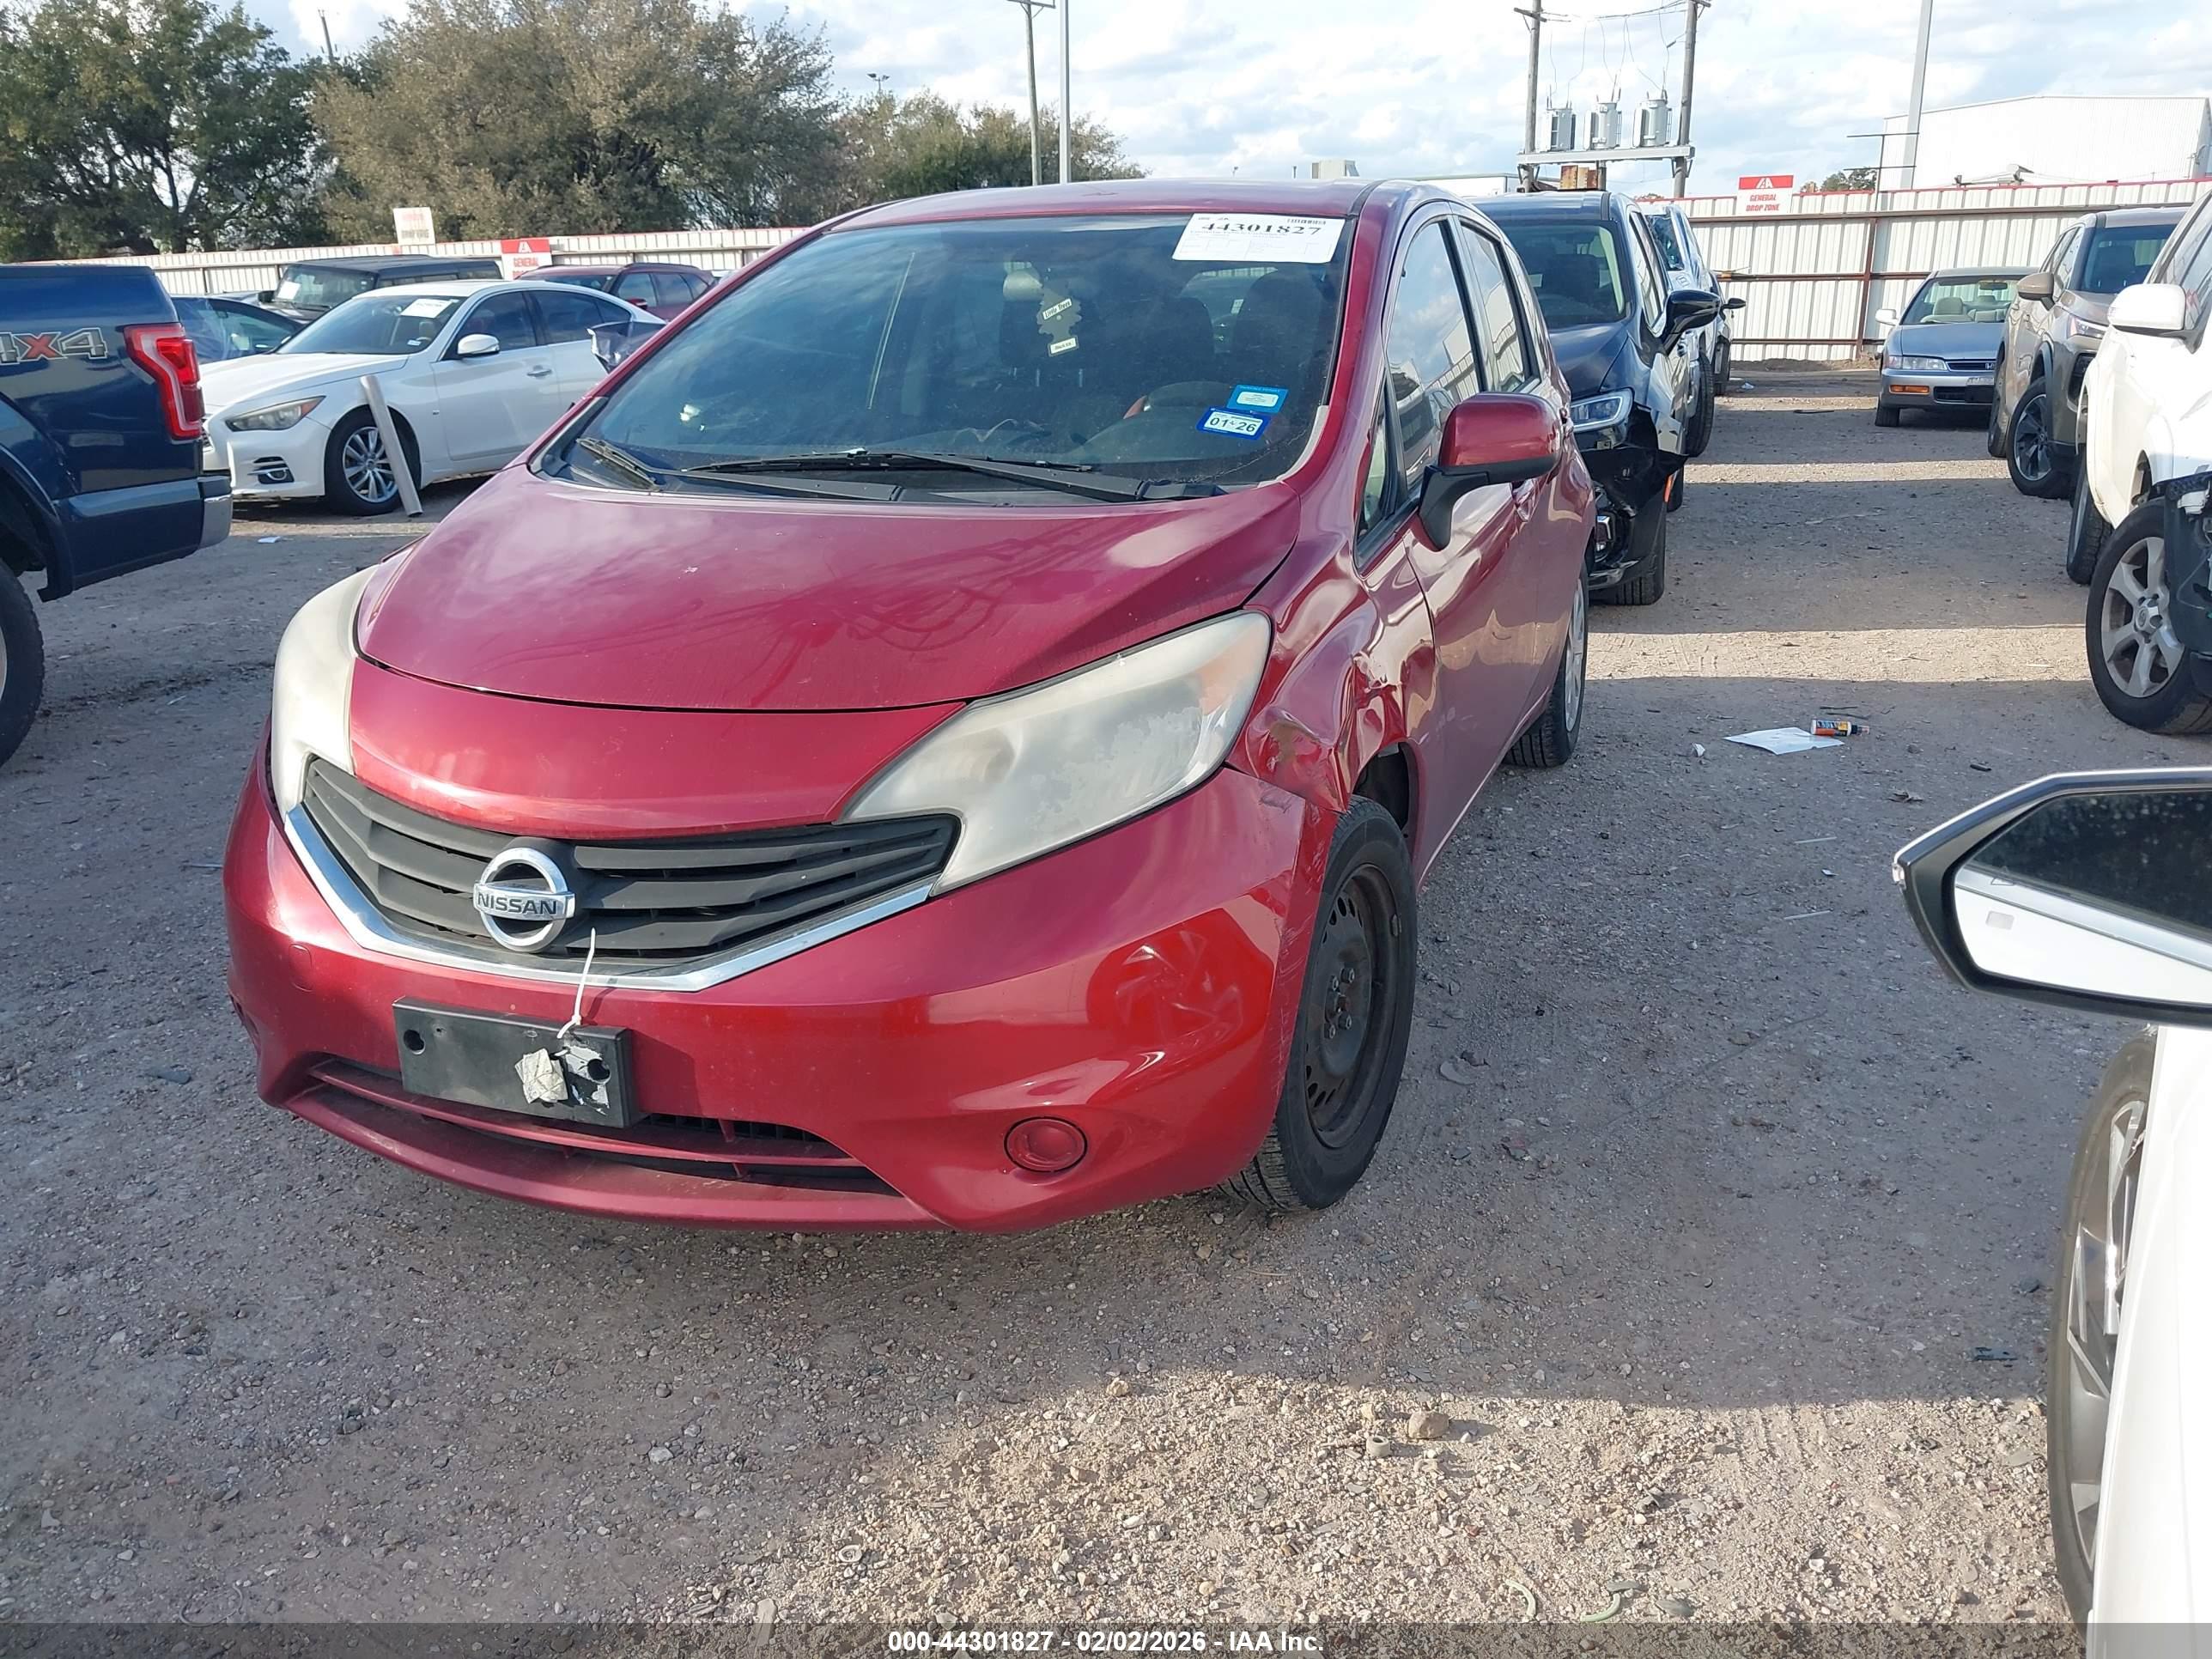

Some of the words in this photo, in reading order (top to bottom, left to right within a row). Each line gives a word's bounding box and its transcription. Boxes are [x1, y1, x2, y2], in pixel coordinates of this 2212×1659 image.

[1202, 222, 1322, 235] 44301827
[1058, 301, 1071, 311] Trees
[1235, 422, 1257, 433] 26
[477, 893, 557, 915] NISSAN
